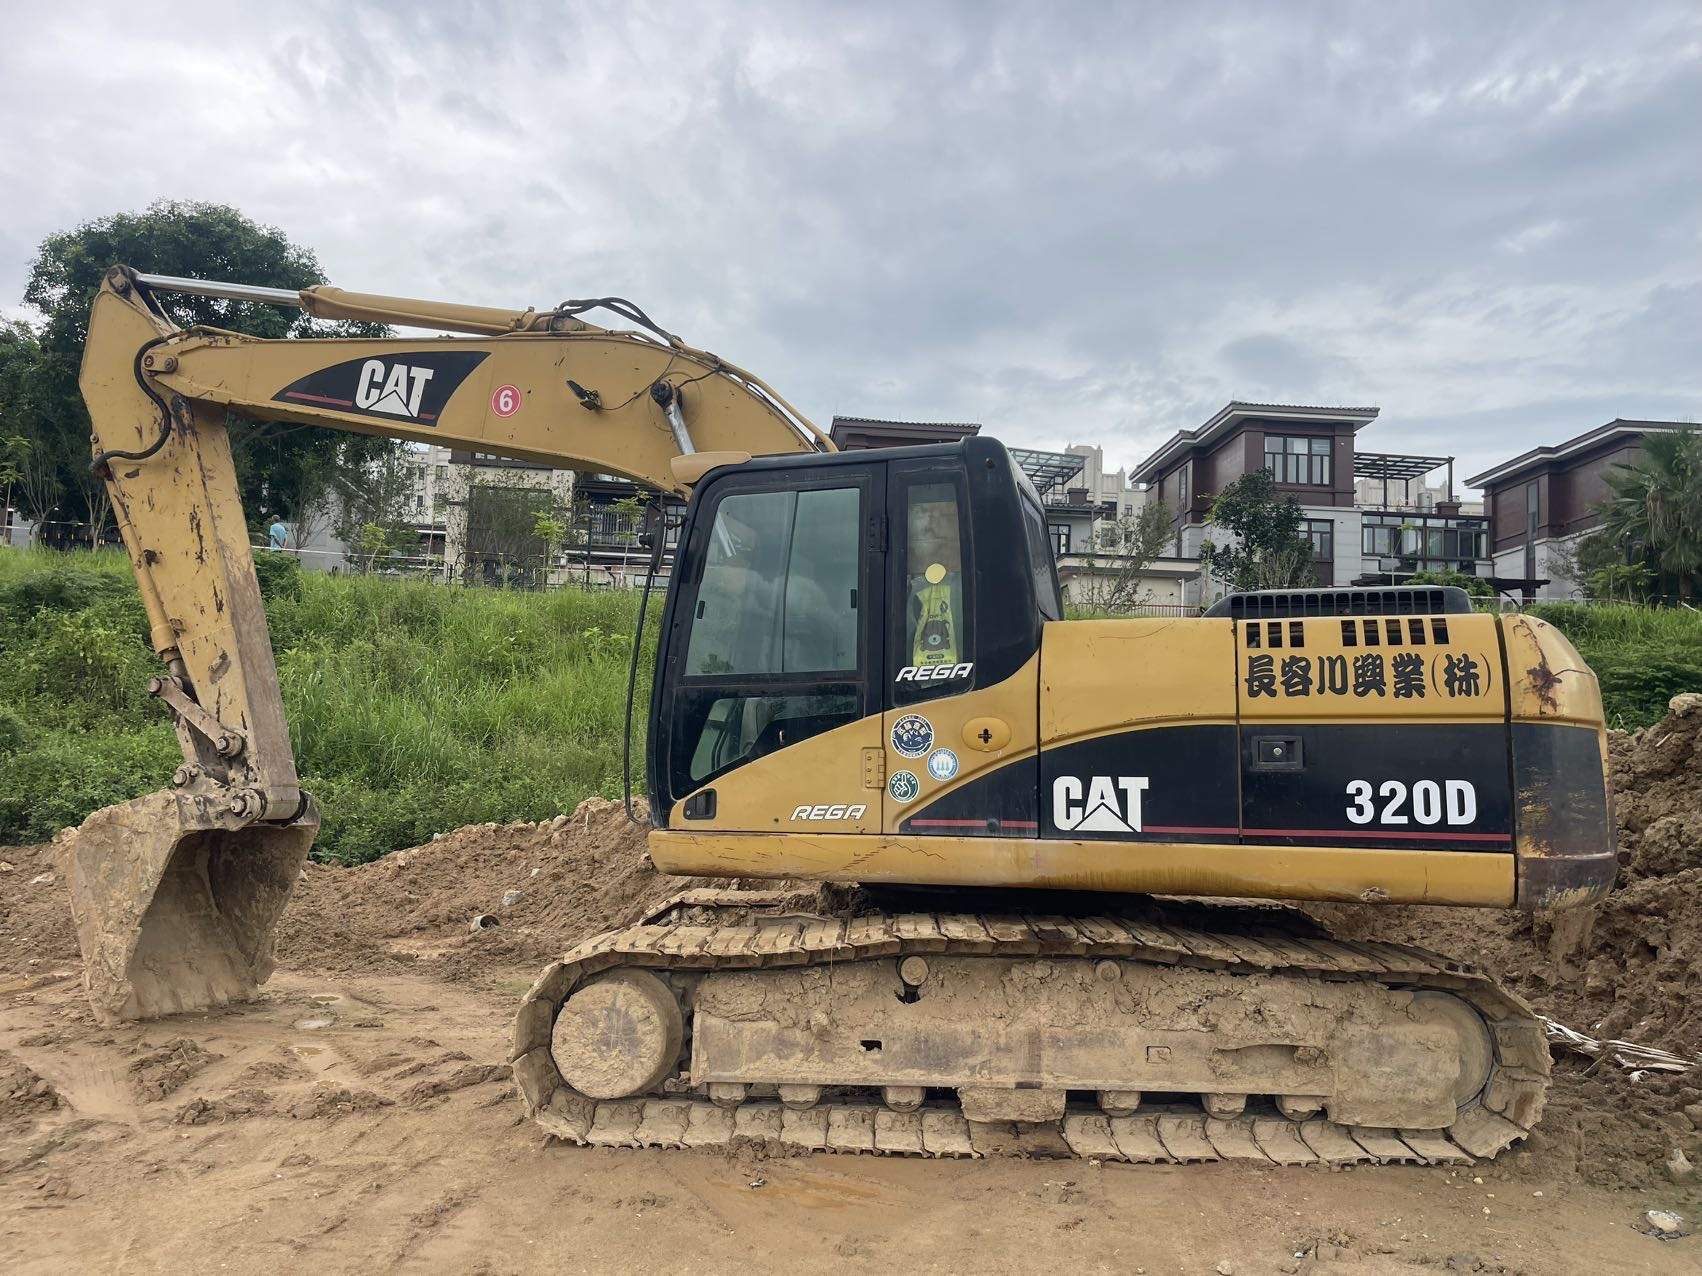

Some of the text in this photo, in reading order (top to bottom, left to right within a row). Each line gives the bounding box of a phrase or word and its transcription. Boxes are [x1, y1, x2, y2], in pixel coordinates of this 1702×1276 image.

[355, 360, 434, 417] CAT
[499, 390, 513, 412] 6
[895, 662, 974, 682] REGA
[790, 804, 867, 821] REGA
[1053, 776, 1149, 833] CAT
[1346, 780, 1477, 825] 320D
